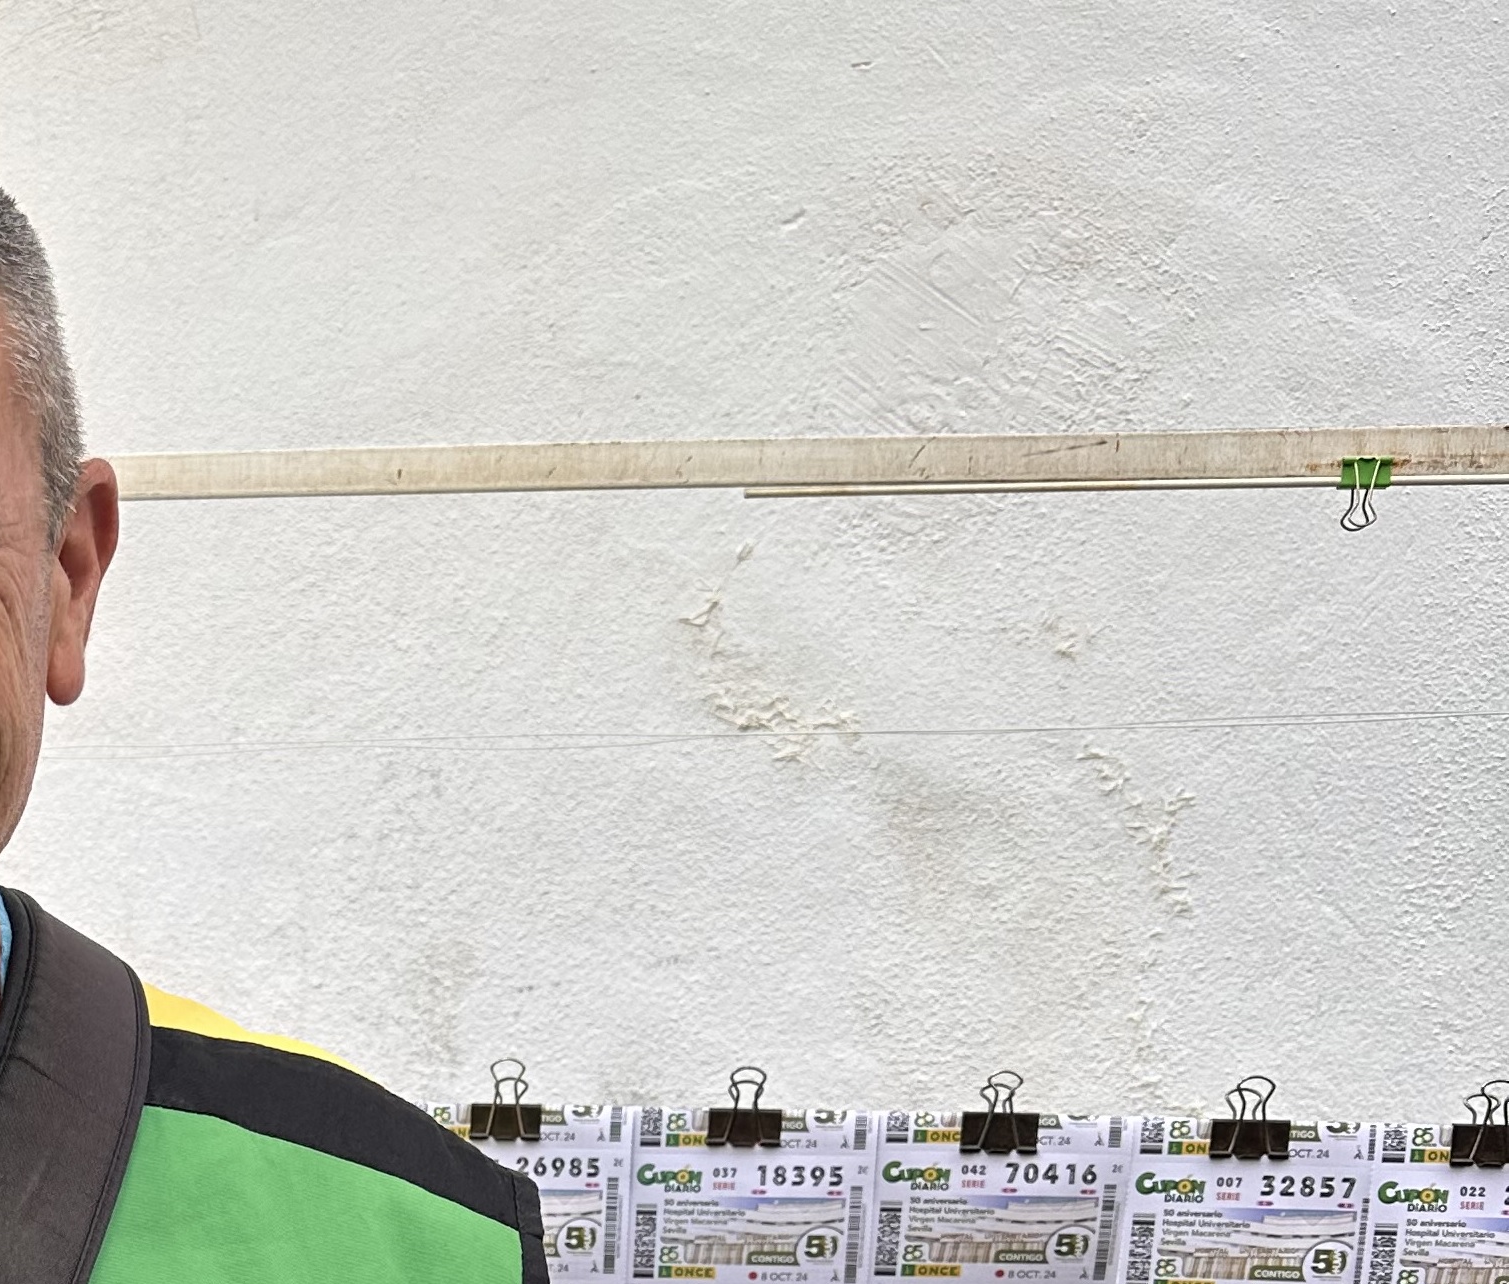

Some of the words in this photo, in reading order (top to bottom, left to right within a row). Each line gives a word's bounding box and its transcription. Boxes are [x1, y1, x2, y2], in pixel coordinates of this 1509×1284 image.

[516, 1156, 600, 1177] 26985
[713, 1167, 737, 1180] 037
[757, 1165, 844, 1186] 18395
[961, 1165, 987, 1176] 042
[1005, 1163, 1098, 1185] 70416
[1216, 1177, 1243, 1188] 007
[1260, 1175, 1356, 1200] 32857
[1460, 1186, 1485, 1198] 022
[750, 1254, 795, 1264] CONTIGO
[999, 1253, 1043, 1262] CONTIGO
[674, 1267, 714, 1278] ONCE
[918, 1265, 958, 1276] ONCE
[1253, 1269, 1300, 1280] CONTIGO
